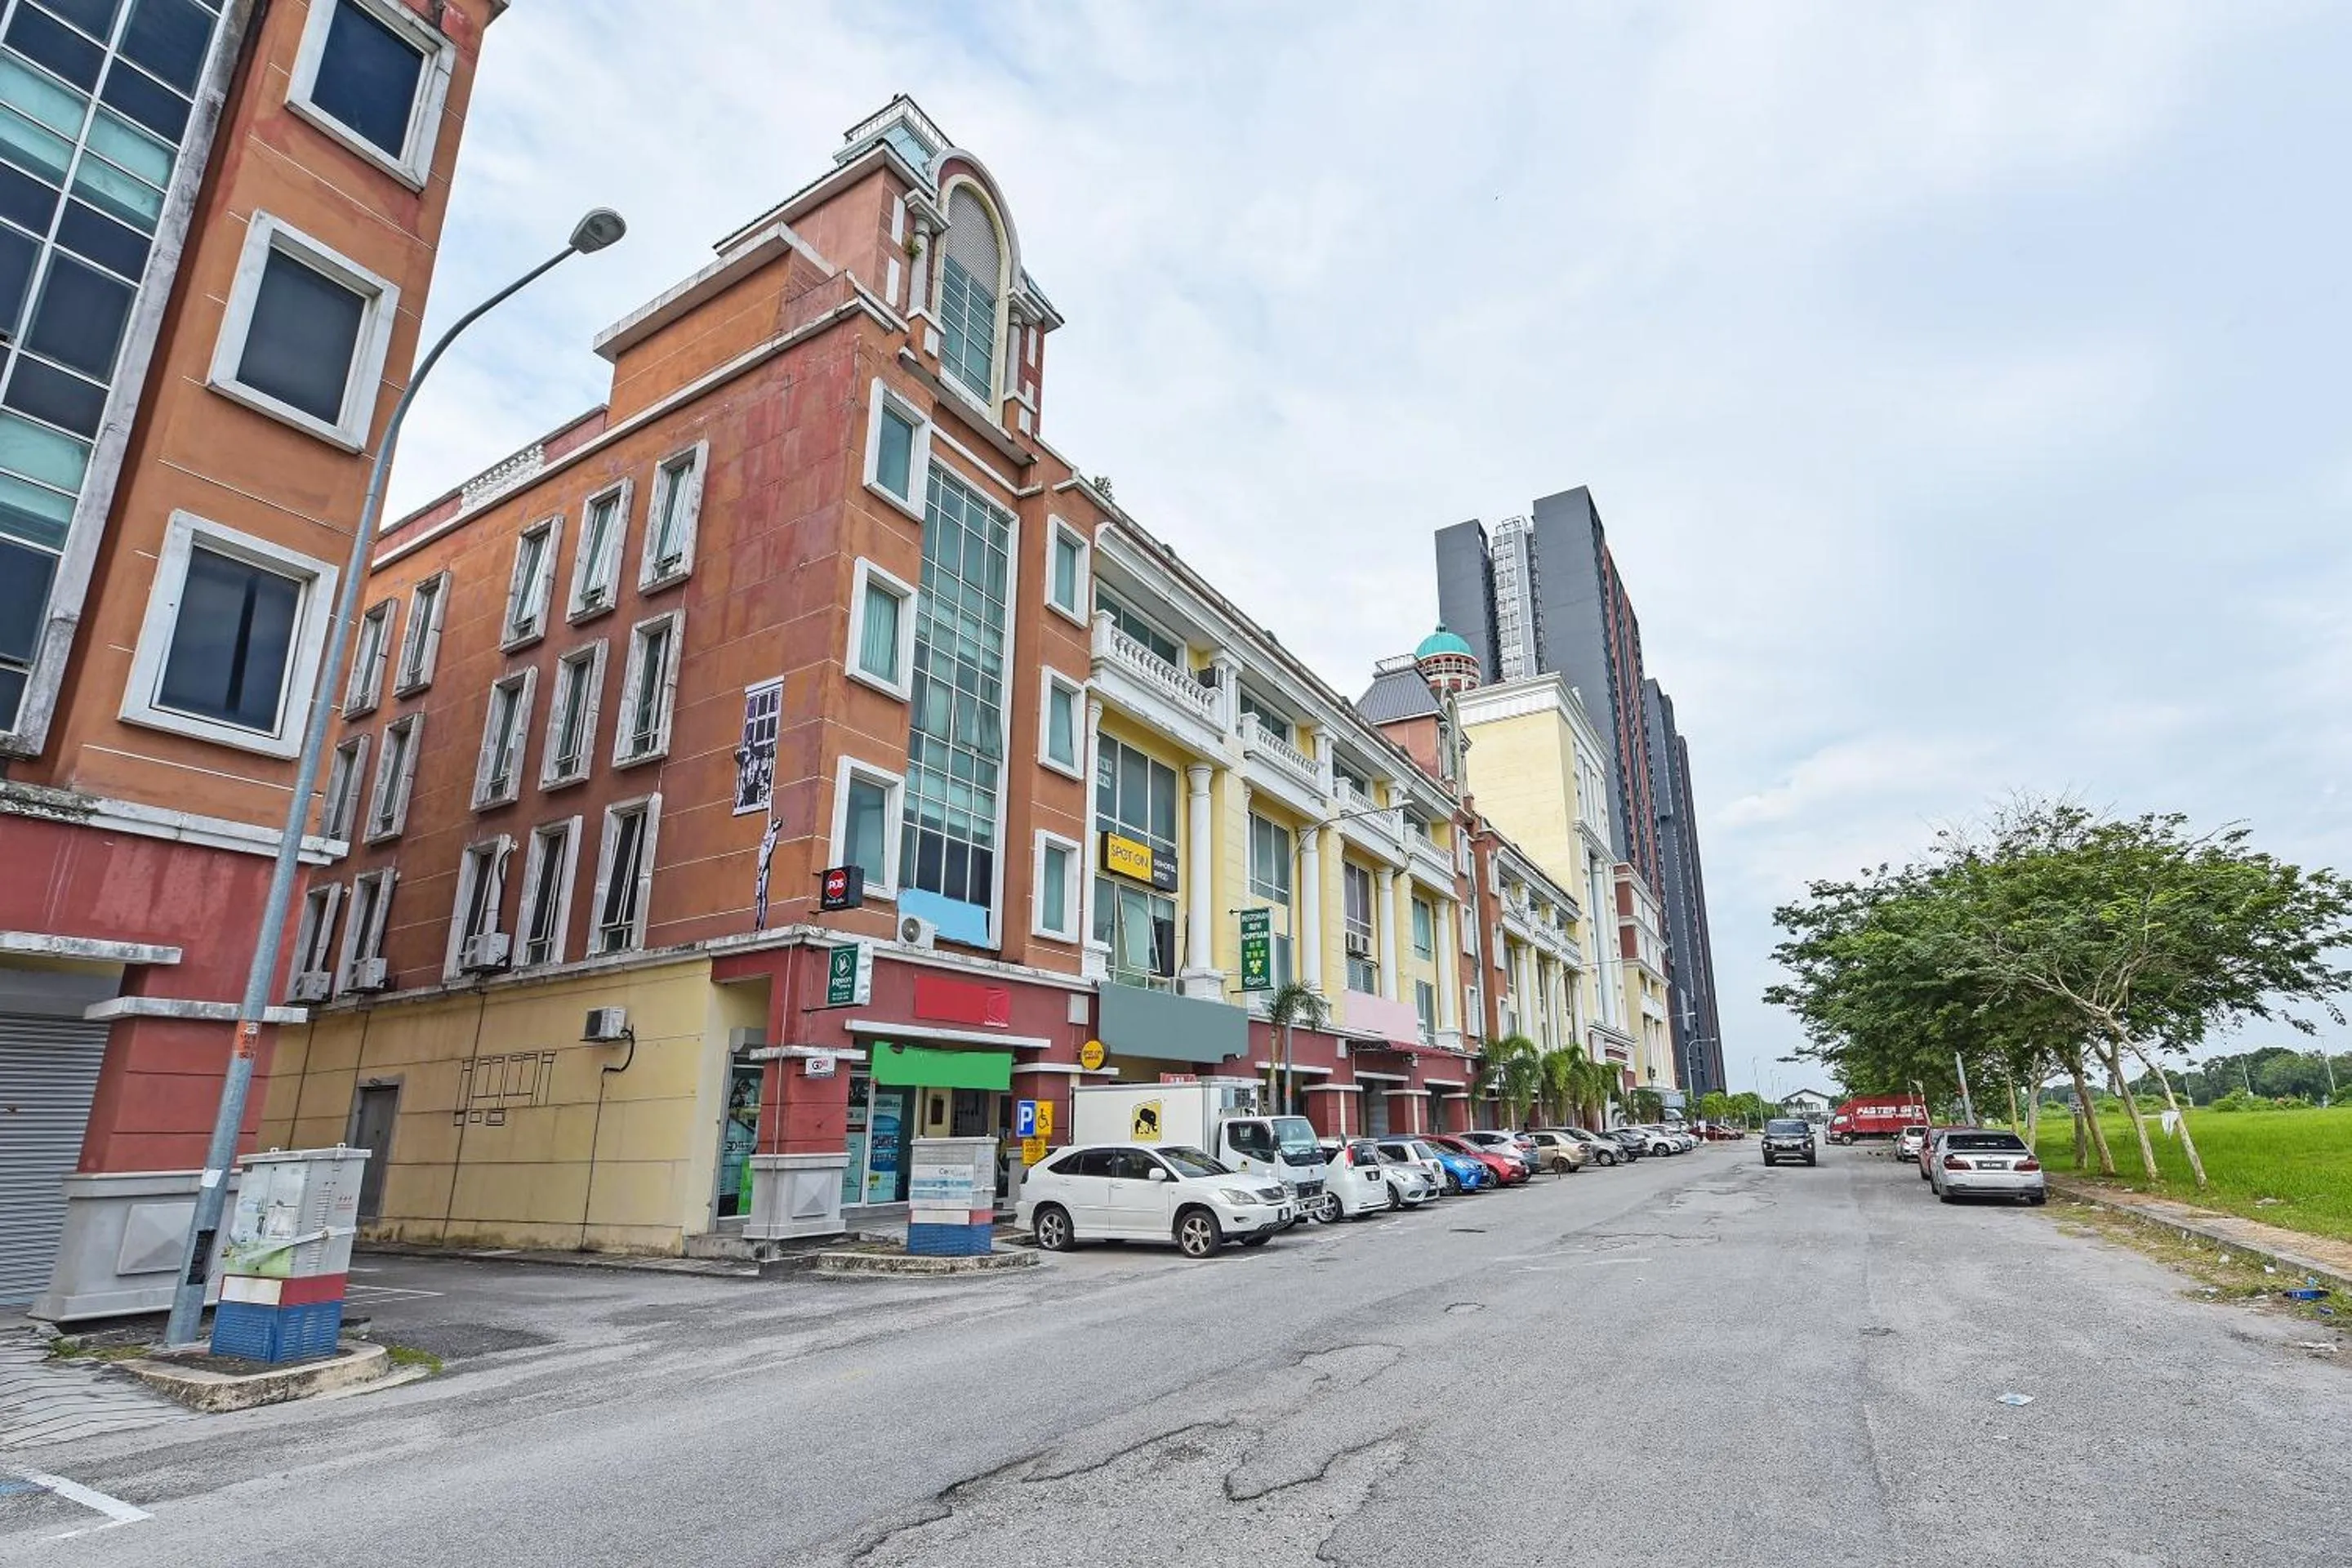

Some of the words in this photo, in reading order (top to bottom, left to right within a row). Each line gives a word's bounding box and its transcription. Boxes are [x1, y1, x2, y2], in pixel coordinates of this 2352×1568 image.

[1111, 844, 1132, 862] SPOT
[1134, 853, 1148, 867] ON
[1020, 1107, 1032, 1131] P
